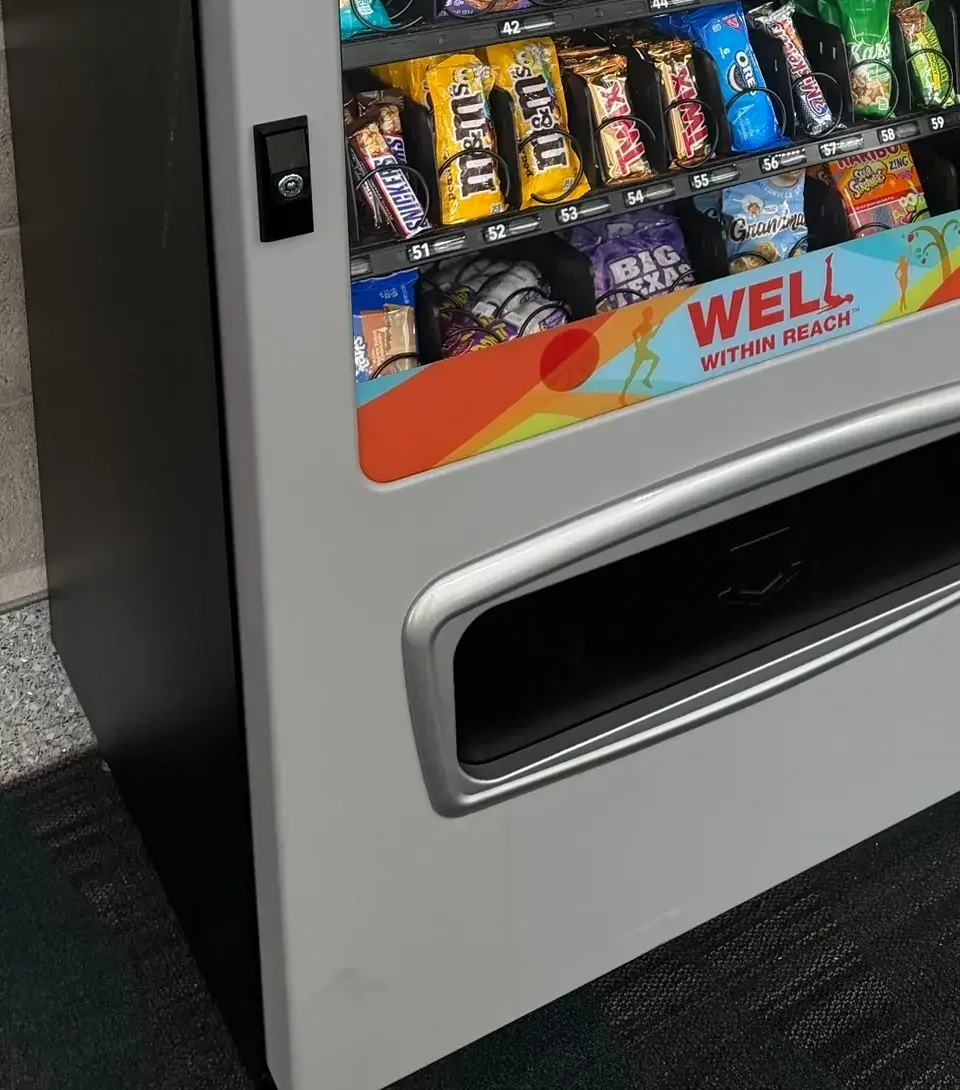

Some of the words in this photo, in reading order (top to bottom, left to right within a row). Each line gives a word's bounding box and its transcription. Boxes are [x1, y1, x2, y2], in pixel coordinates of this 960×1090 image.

[502, 21, 521, 35] 42
[508, 64, 570, 173] m&m's
[668, 67, 709, 159] TWIX
[599, 78, 646, 177] TWIX
[931, 116, 944, 130] 59
[449, 81, 499, 200] m&m's
[880, 129, 896, 142] 58
[823, 143, 837, 156] 57
[763, 157, 779, 170] 56
[854, 166, 872, 181] SOUR
[693, 174, 709, 189] 55
[374, 156, 429, 232] SNICKERS
[626, 191, 644, 206] 54
[763, 188, 794, 200] VANILLA
[560, 206, 579, 221] 53
[487, 225, 506, 240] 52
[413, 243, 431, 259] 51
[609, 245, 681, 283] BIG
[687, 251, 855, 348] WELL
[700, 333, 776, 372] WITHIN
[783, 312, 852, 348] REACH
